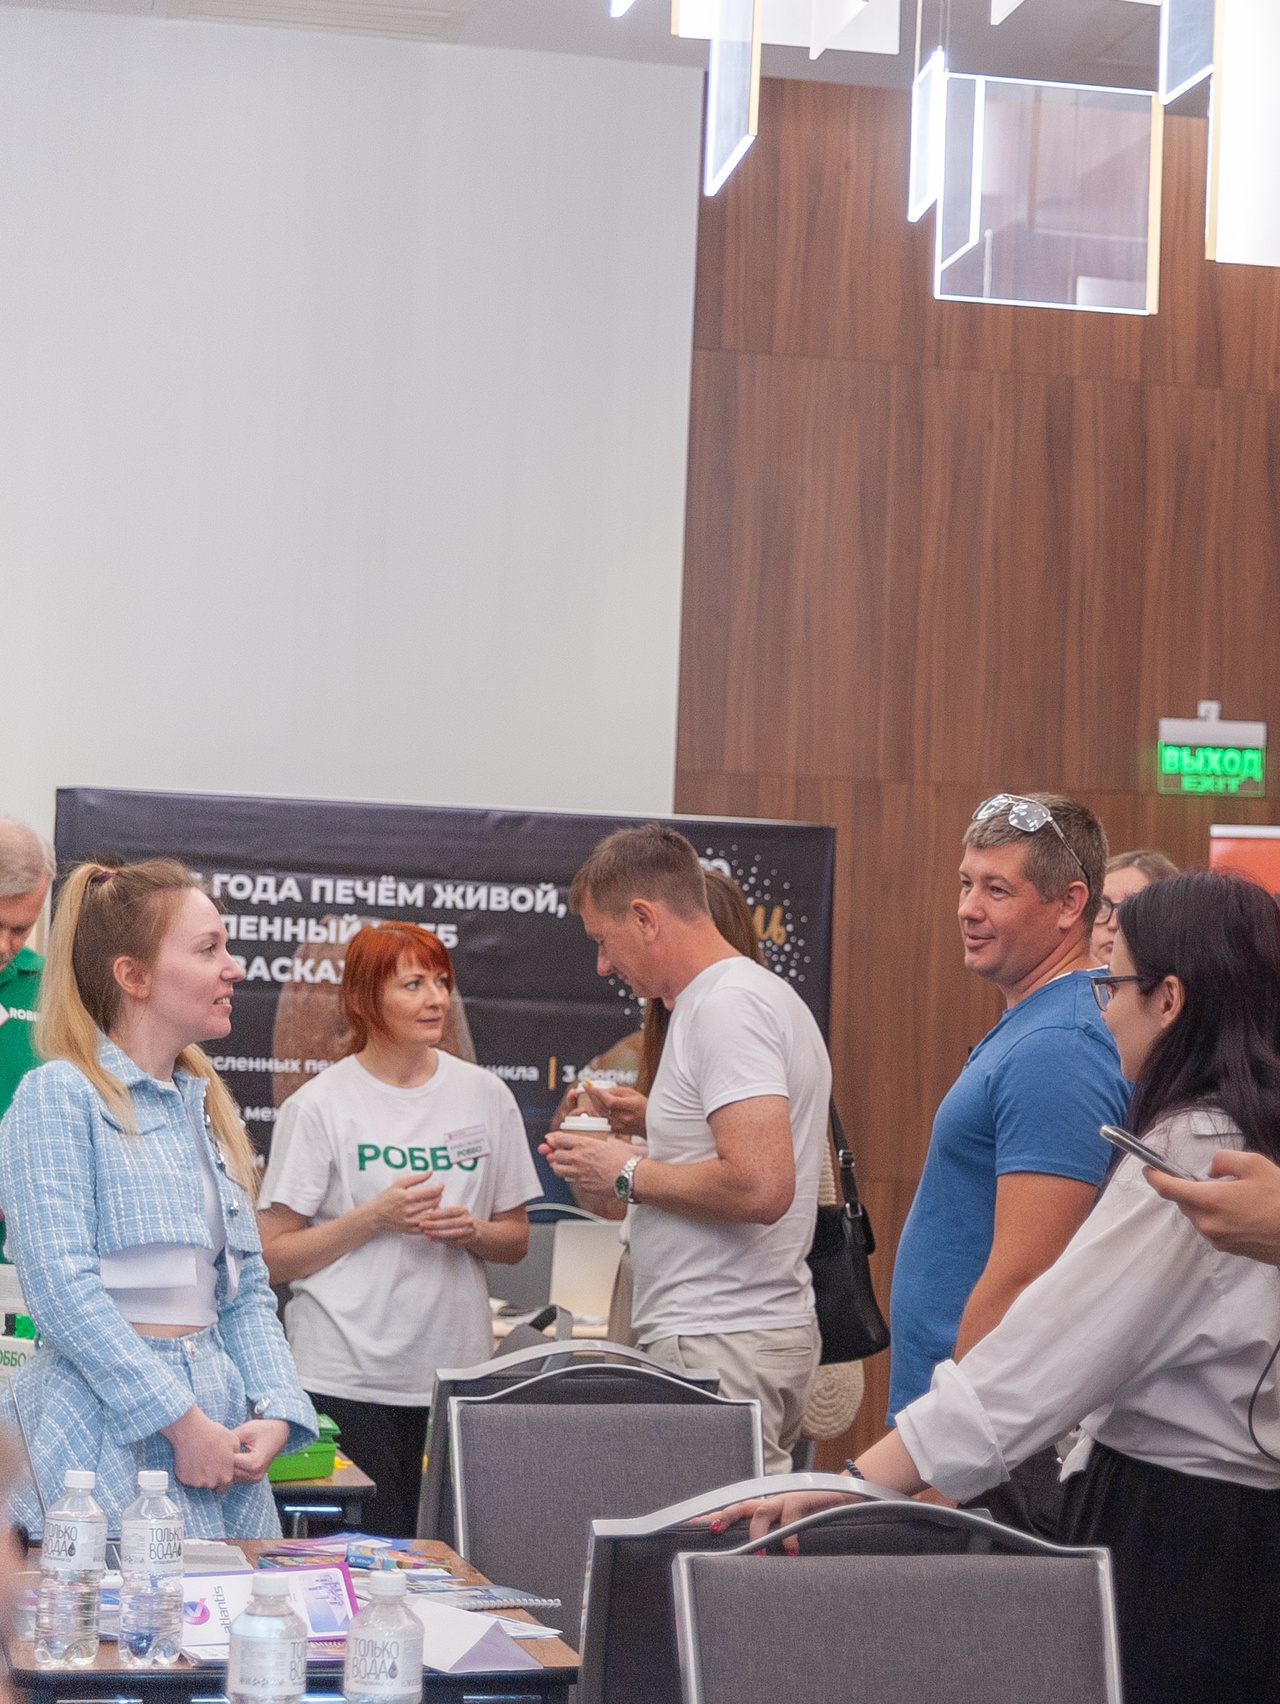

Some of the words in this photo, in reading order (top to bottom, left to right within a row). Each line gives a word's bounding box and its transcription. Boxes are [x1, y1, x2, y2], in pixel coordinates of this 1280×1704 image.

[1162, 745, 1263, 782] ВЫХОД
[1181, 775, 1239, 793] EXIT
[212, 873, 302, 905] ГОДА
[310, 875, 425, 908] ПЕЧЁМ
[431, 883, 567, 919] ЖИВОЙ,
[149, 1542, 178, 1560] ВОДА
[354, 1638, 400, 1660] ТОЛЬКО
[352, 1657, 389, 1680] ВОДА
